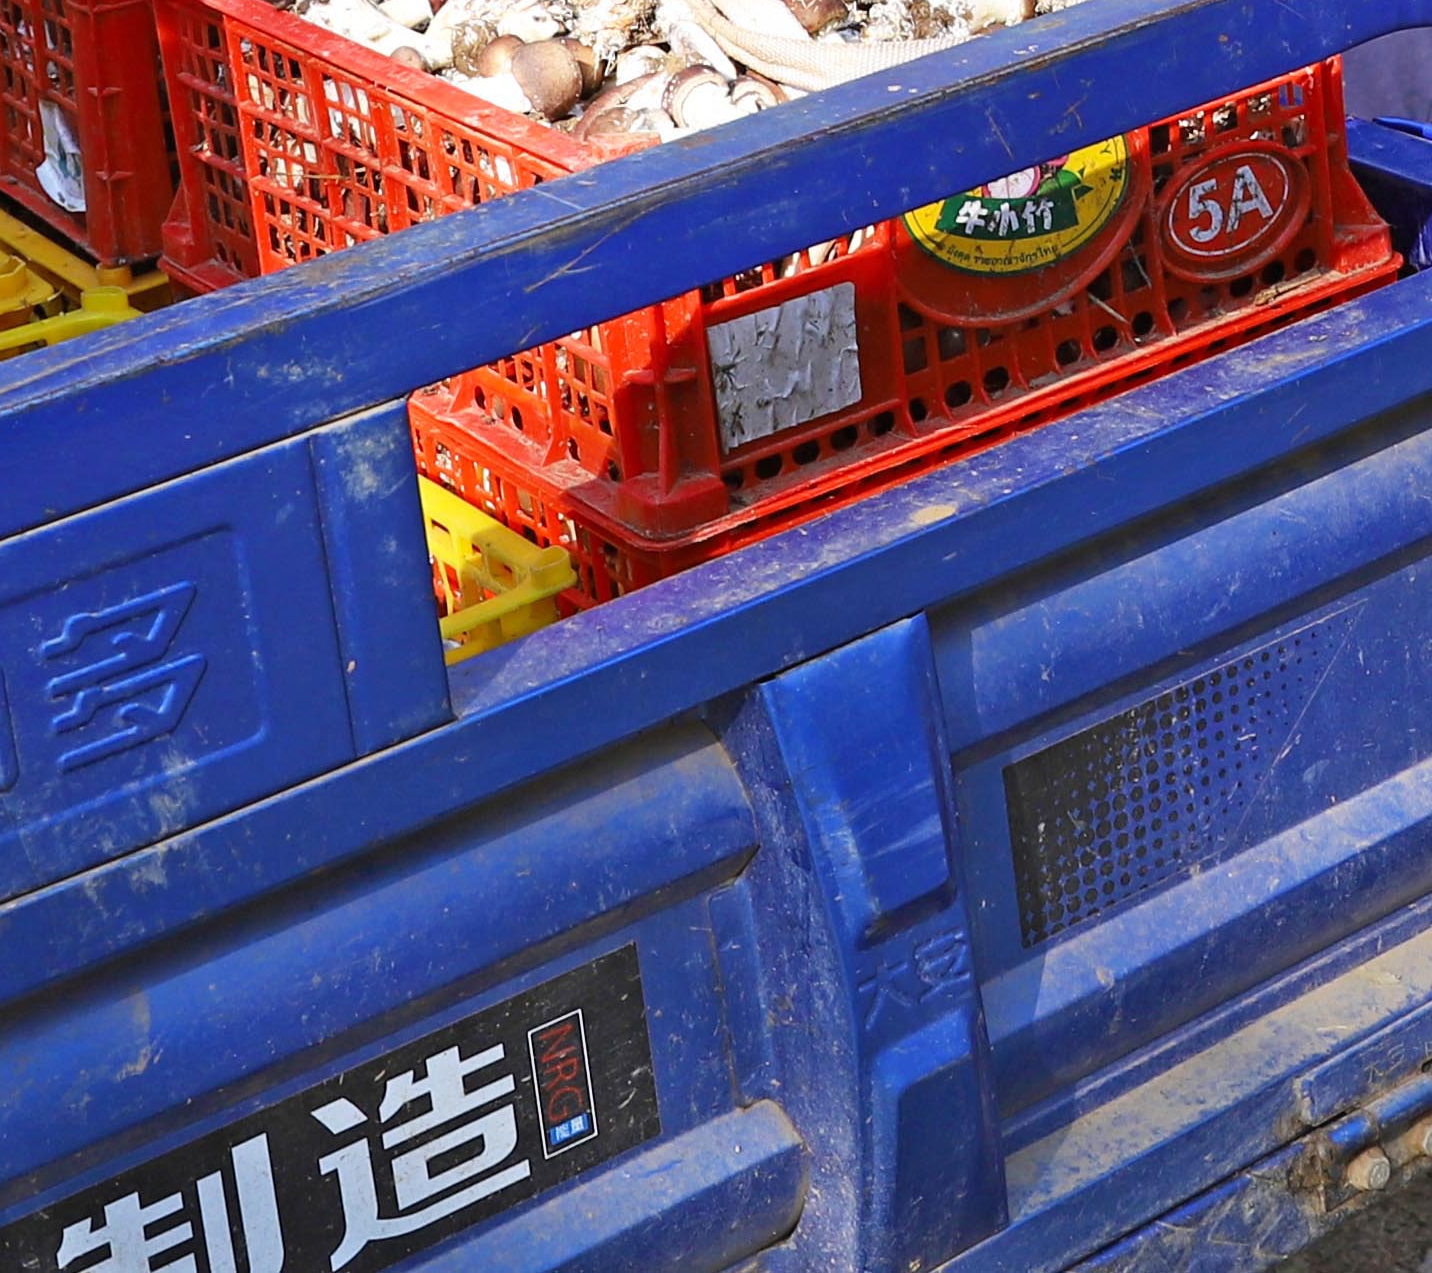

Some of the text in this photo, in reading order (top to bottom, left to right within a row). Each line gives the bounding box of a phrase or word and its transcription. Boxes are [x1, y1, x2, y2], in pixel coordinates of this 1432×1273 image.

[1188, 165, 1274, 243] 5A
[537, 1021, 585, 1123] NRG
[56, 1043, 531, 1273] 制造
